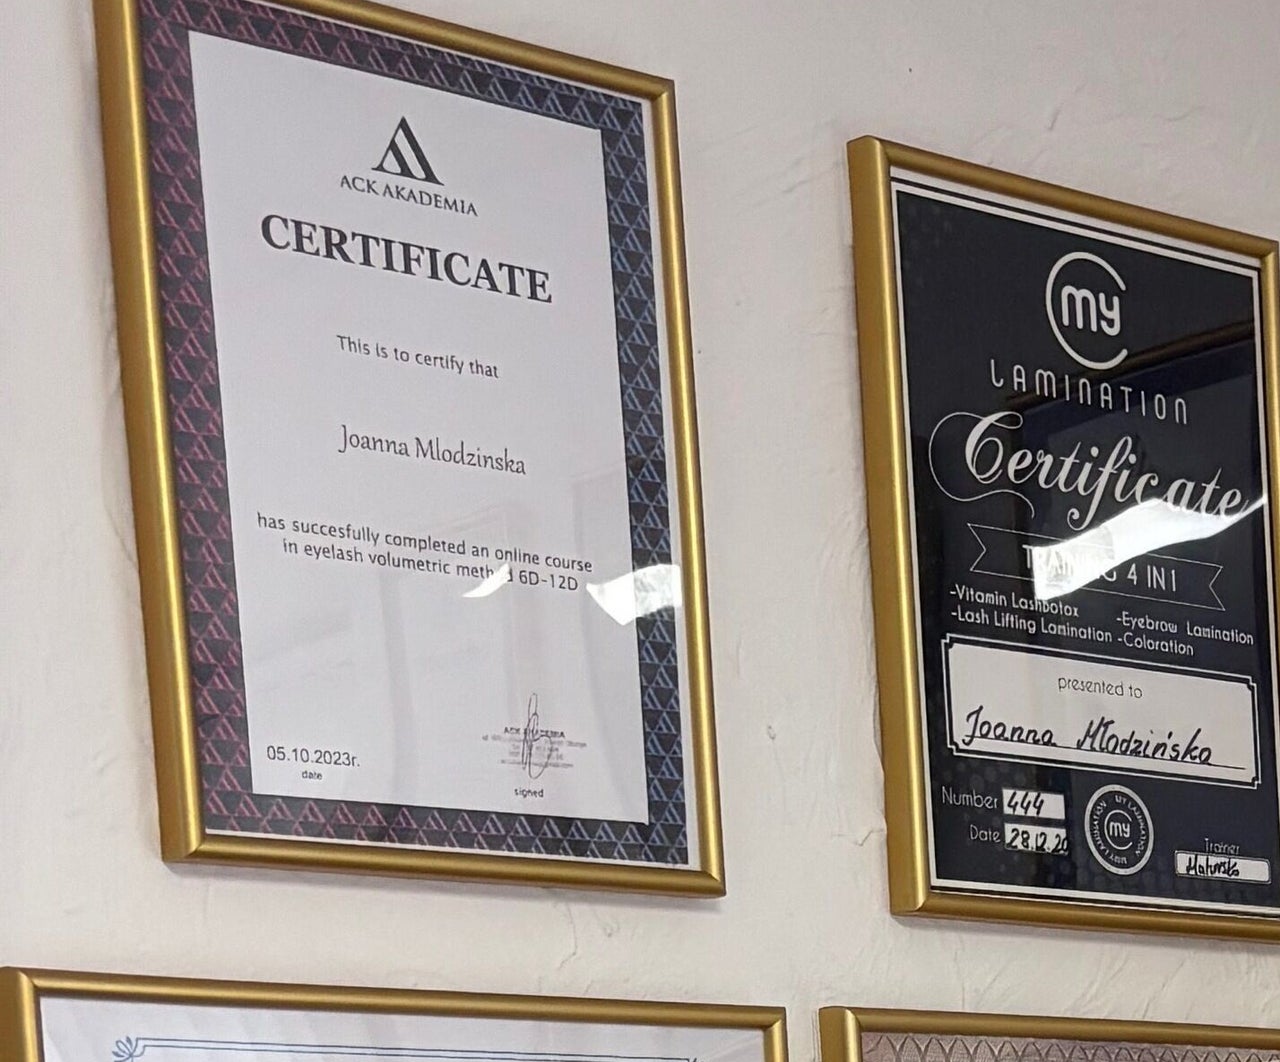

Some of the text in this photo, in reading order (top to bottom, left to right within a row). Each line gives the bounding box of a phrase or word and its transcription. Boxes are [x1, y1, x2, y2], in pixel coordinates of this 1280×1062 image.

[340, 174, 478, 216] ACK AKADEMIA
[261, 214, 552, 303] CERTIFICATE
[1061, 285, 1121, 336] my
[337, 335, 498, 378] This is to certify that
[991, 359, 1187, 425] LAMINATION
[338, 424, 526, 475] Joanna Mlodzinska
[929, 411, 1248, 530] Certificate
[257, 512, 592, 573] has succesfully completed an online course
[283, 539, 298, 554] in
[304, 543, 363, 564] eyelash
[368, 551, 450, 575] volumetric
[519, 570, 578, 591] 6D-12D
[994, 613, 1035, 633] Lifting
[1041, 617, 1112, 642] Lamination
[1187, 621, 1254, 645] Lamination
[1058, 676, 1142, 698] presented to
[962, 706, 1056, 746] Joanna
[267, 746, 360, 767] 05.10.2023r.
